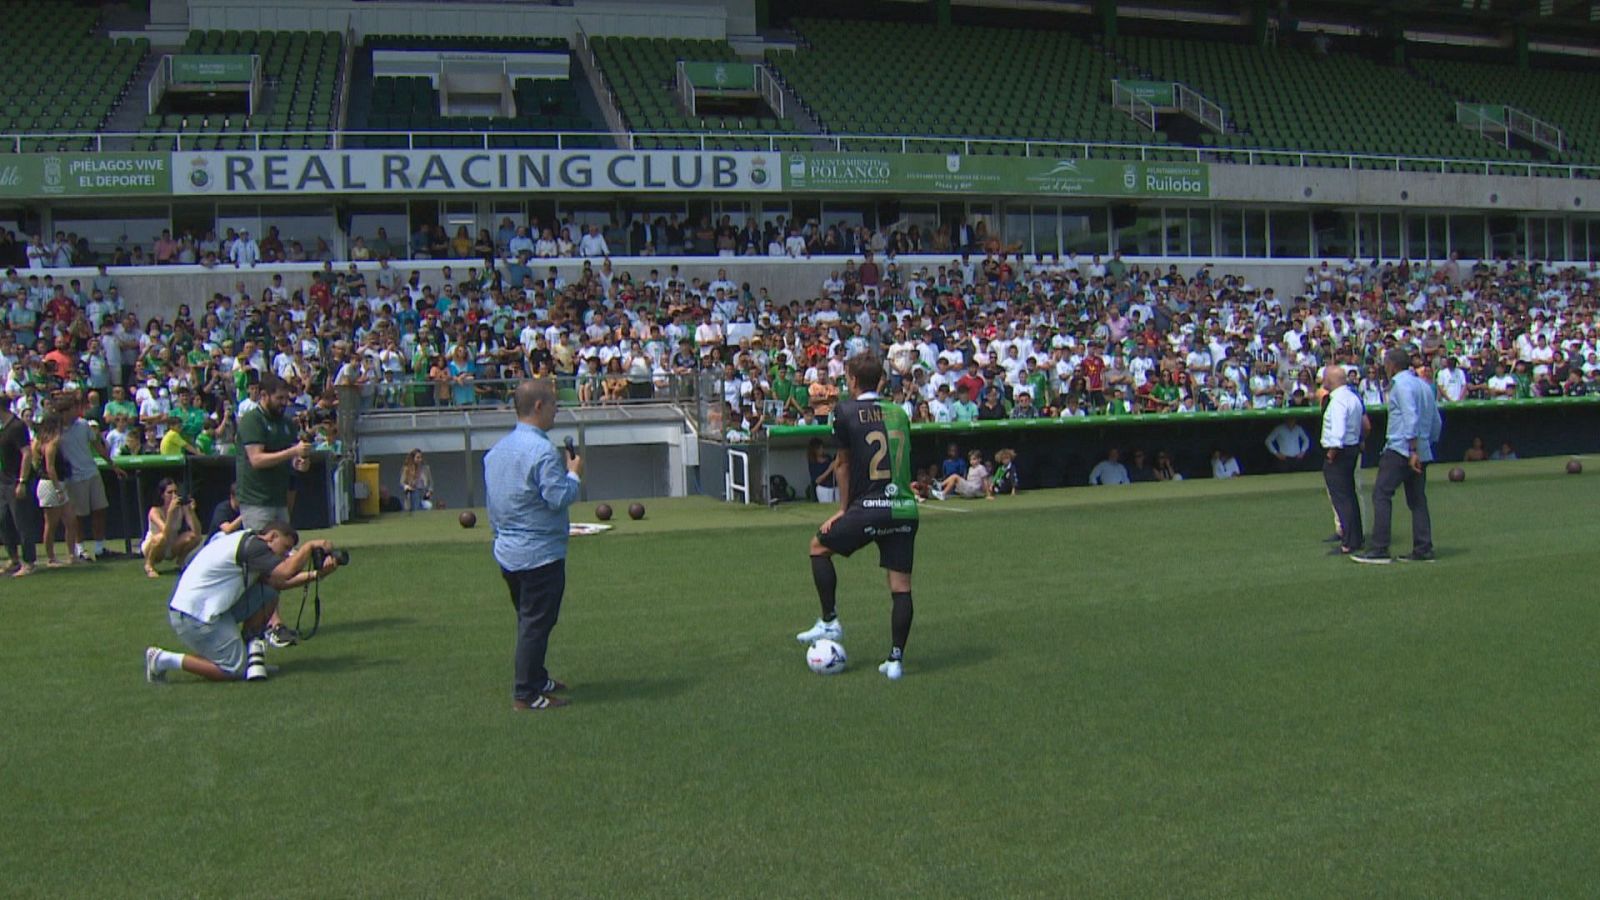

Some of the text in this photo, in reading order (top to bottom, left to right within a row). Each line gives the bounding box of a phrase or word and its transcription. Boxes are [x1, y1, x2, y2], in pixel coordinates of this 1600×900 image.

[134, 159, 164, 171] VIVE
[224, 152, 740, 192] REAL RACING CLUB
[811, 165, 890, 179] POLANCO
[79, 175, 155, 187] EL DEPORTE!
[1146, 175, 1201, 192] Ruiloba
[864, 430, 906, 480] 27
